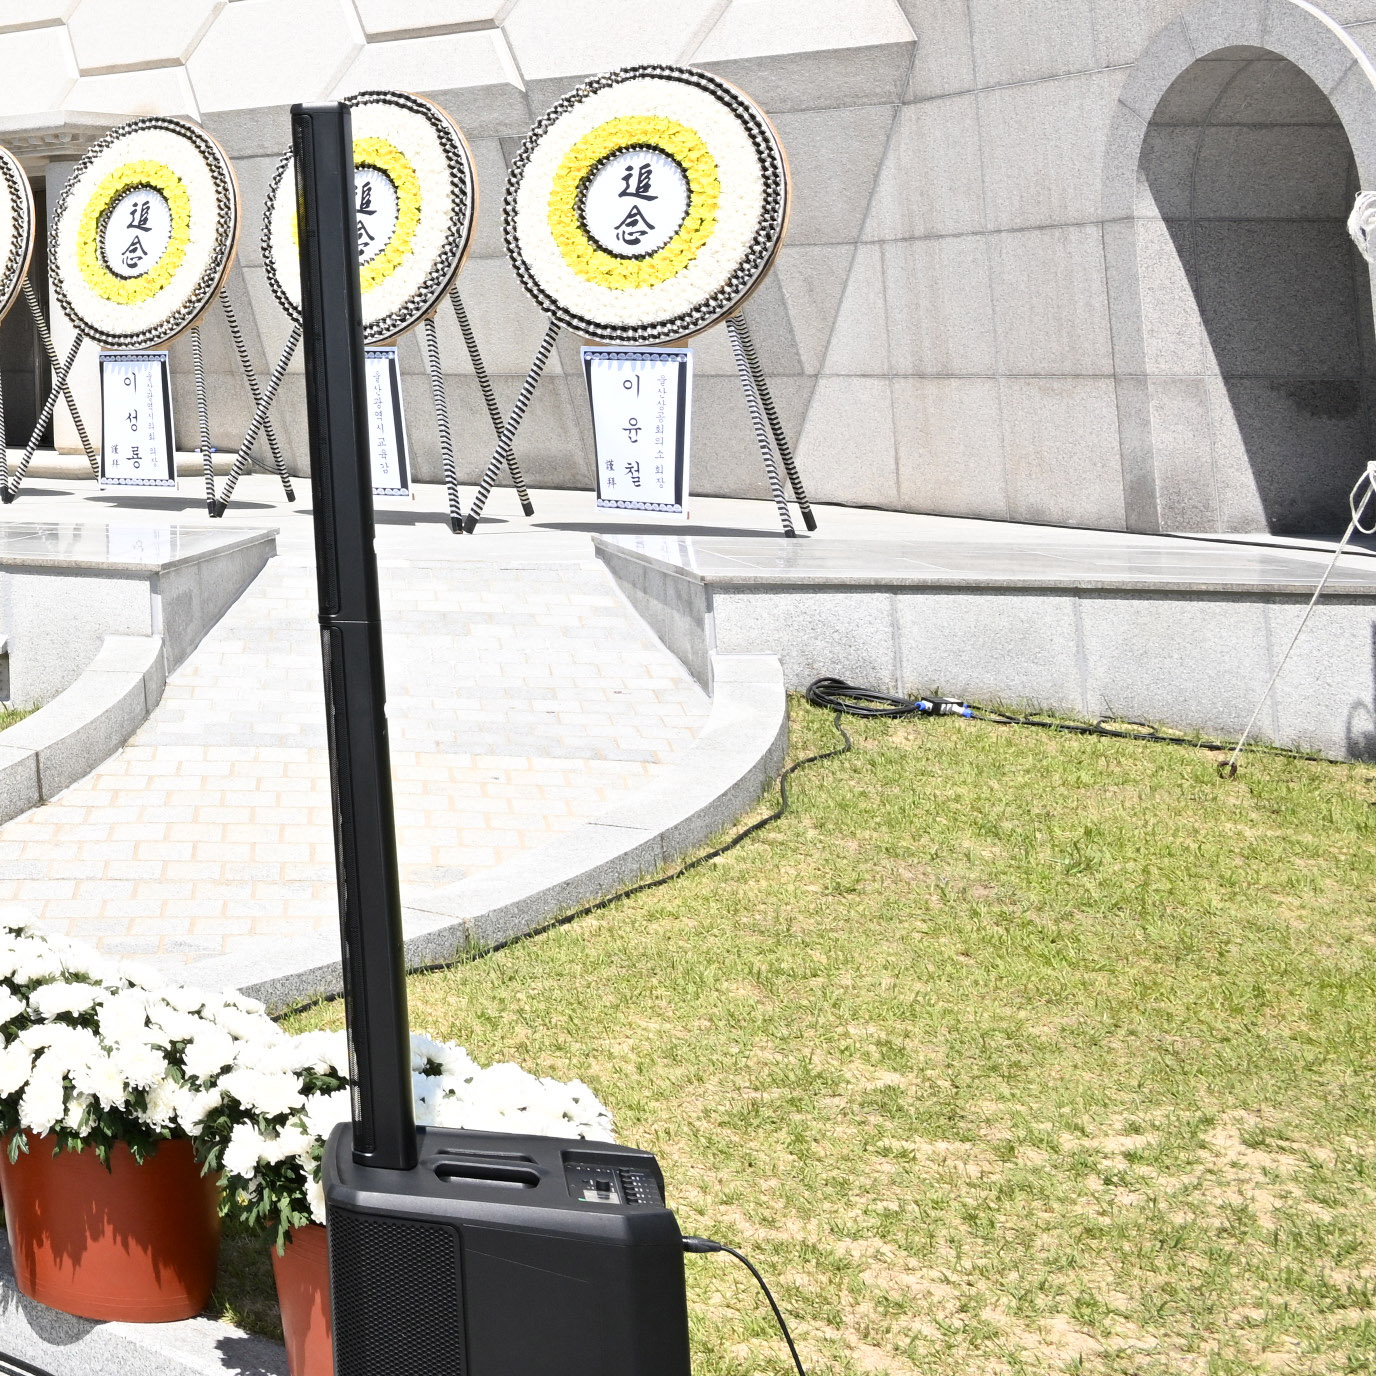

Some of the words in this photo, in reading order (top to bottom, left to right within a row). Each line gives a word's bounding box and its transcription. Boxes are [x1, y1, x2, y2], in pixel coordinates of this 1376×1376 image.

[122, 201, 153, 268] 追念
[615, 164, 658, 245] 追念
[622, 374, 642, 487] 이윤철
